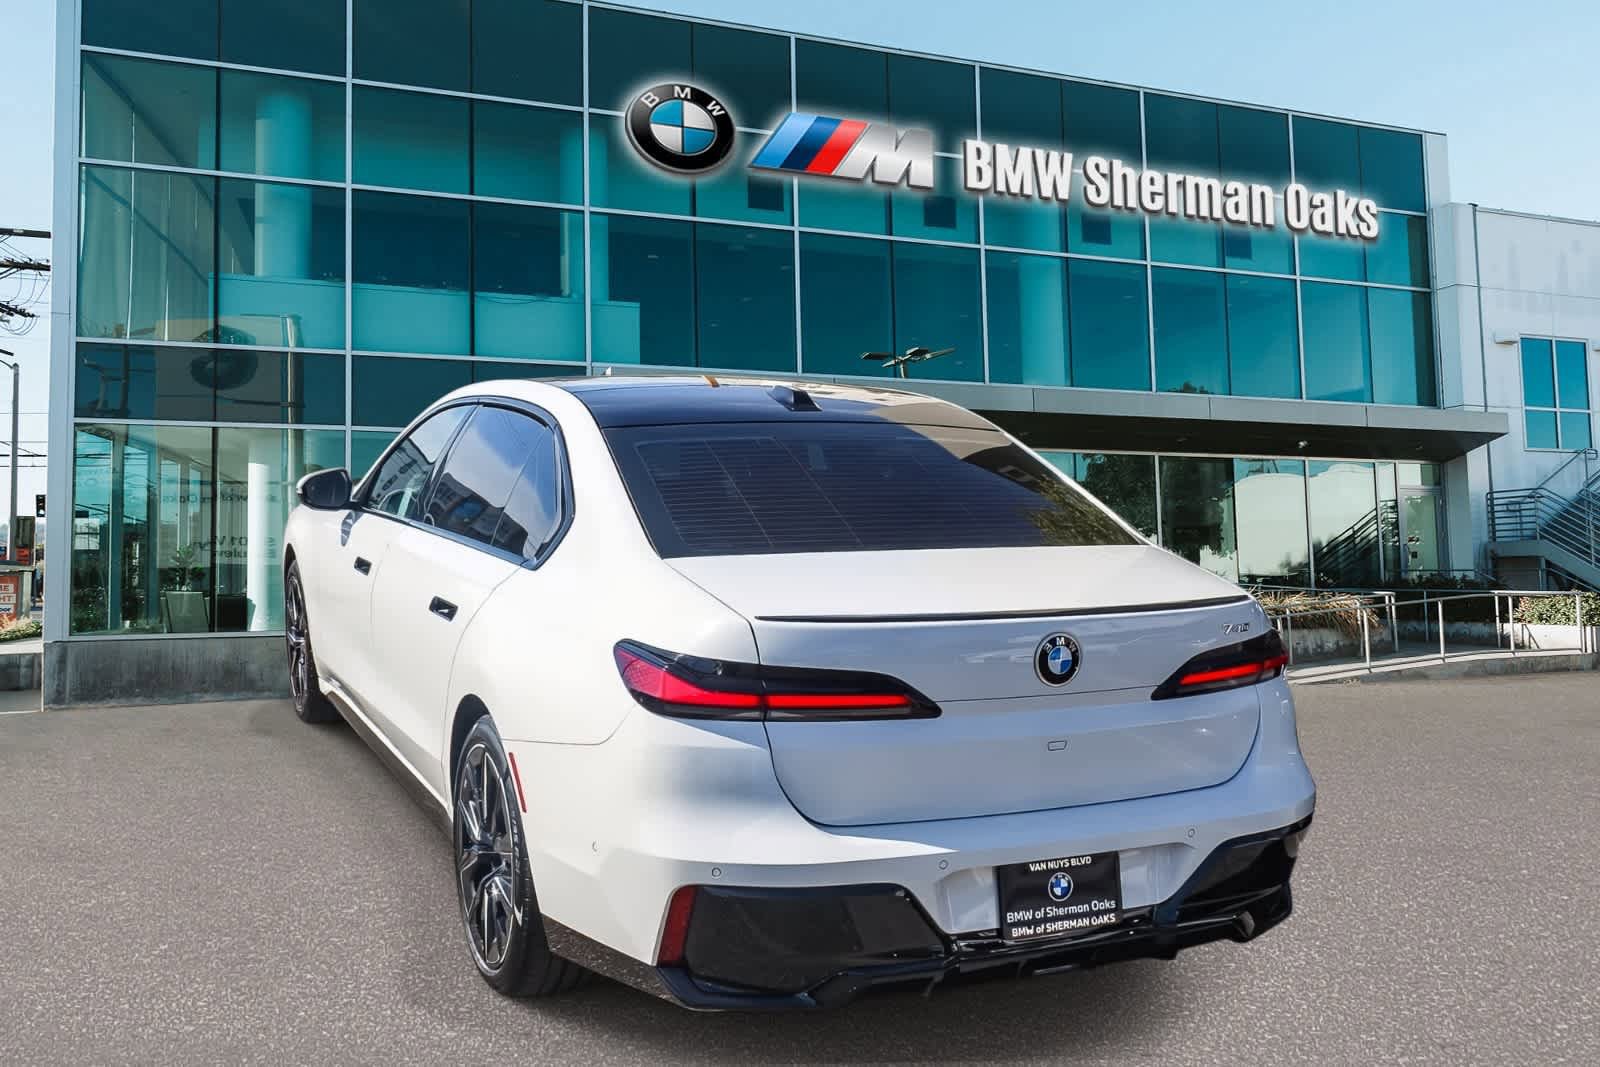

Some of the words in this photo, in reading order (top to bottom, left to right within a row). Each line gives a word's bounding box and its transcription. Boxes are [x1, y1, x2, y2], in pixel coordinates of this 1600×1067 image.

[641, 85, 725, 118] BMW
[963, 138, 1074, 202] BMW
[1083, 156, 1275, 227] Sherman
[1284, 182, 1380, 240] Oaks
[1044, 636, 1077, 654] BMW
[1029, 862, 1047, 872] VAN
[1048, 859, 1070, 870] NUYS
[1071, 856, 1092, 866] BLVD
[1006, 909, 1033, 923] BMW
[1035, 907, 1046, 918] of
[1046, 903, 1090, 918] Sherman
[1091, 899, 1116, 911] Oaks
[1011, 925, 1034, 937] BMW
[1036, 923, 1046, 934] of
[1046, 917, 1090, 933] SHERMAN
[1091, 913, 1116, 925] OAKS
